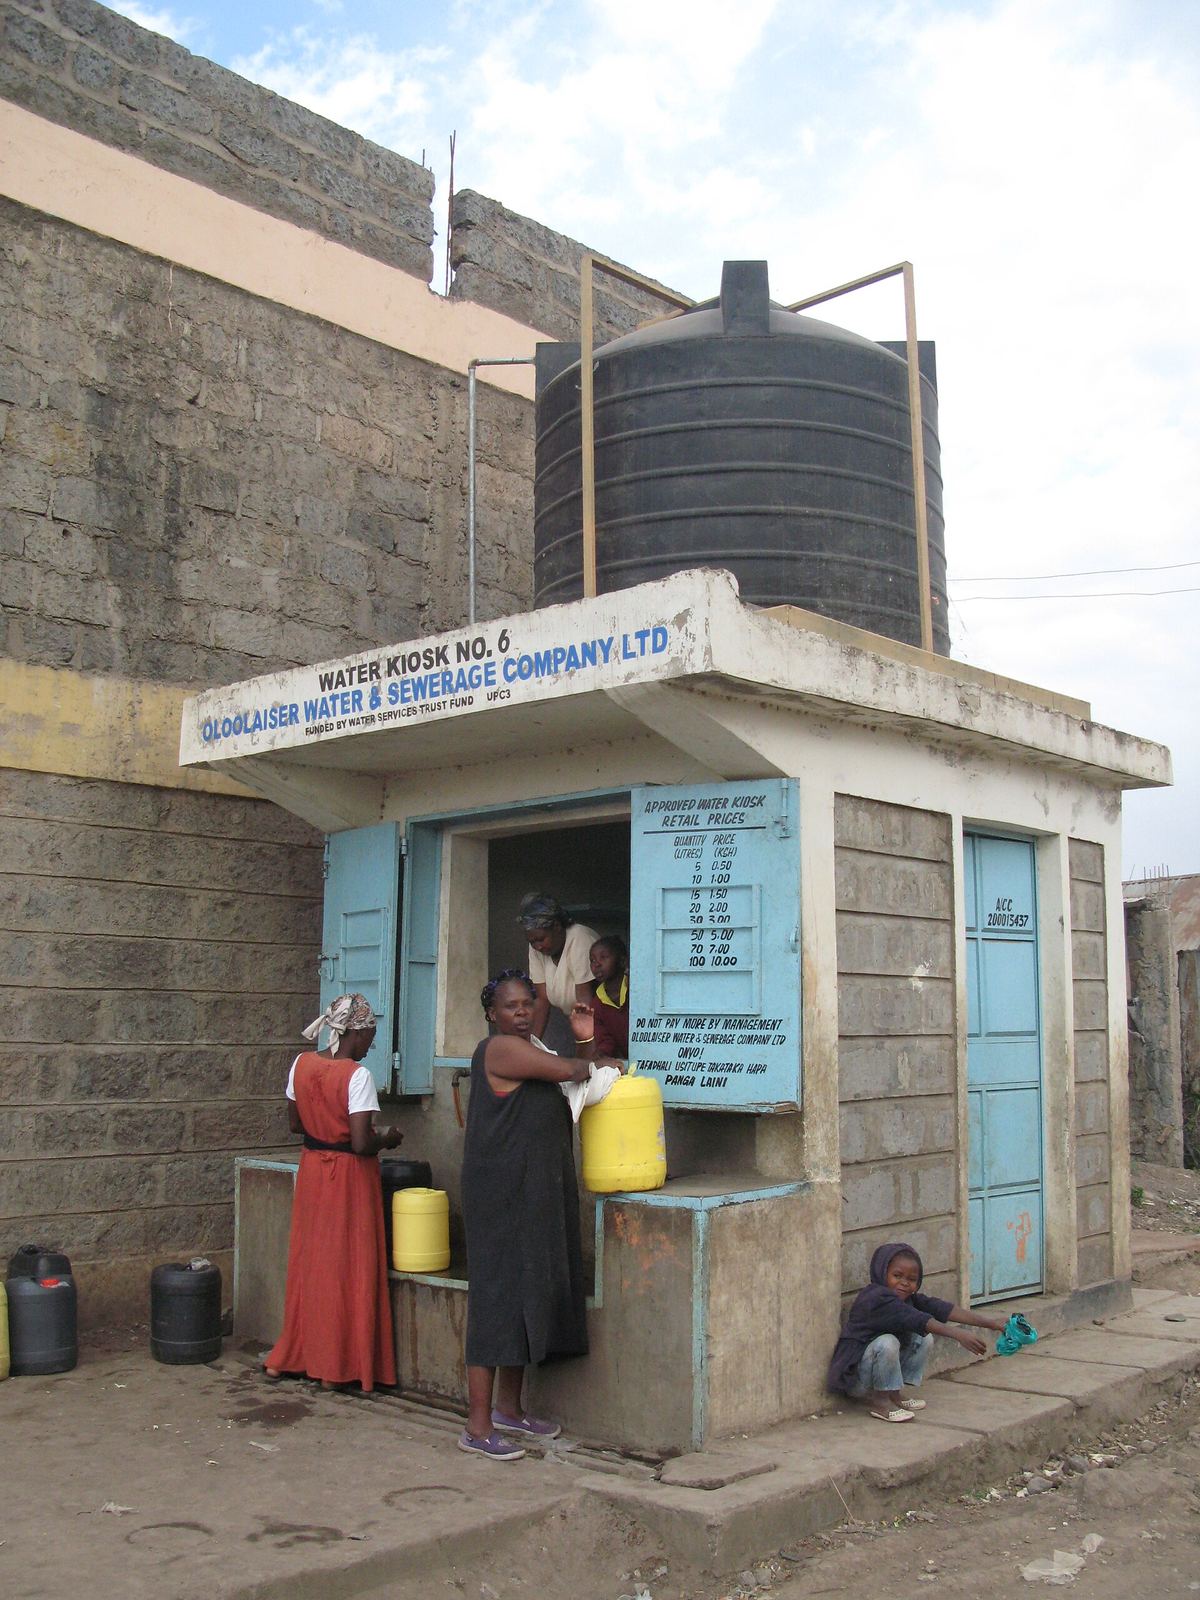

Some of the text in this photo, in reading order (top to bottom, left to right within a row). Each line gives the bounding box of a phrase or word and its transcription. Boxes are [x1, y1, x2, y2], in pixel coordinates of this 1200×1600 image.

[318, 628, 511, 692] WATER KIOSK NO. 6
[202, 626, 668, 742] OLOOLAISER WATER & SEWERAGE COMPANY LTD
[305, 689, 511, 736] FUNDED BY WATER SERVICES TRUST FUND UPC3
[645, 795, 767, 813] APPROVED WATER KIOSK
[662, 812, 746, 827] RETAIL PRICES
[673, 833, 736, 846] QUANTITY PRICE
[674, 846, 738, 859] (LITRES) (KSH)
[695, 860, 732, 871] 5 0.50
[692, 873, 730, 884] 10 1.00
[691, 888, 728, 900] 15 1.50
[689, 902, 728, 913] 20 2.00
[689, 915, 731, 924] 30 300
[690, 929, 734, 941] 50 5.00
[690, 943, 730, 954] 70 7.00
[689, 955, 738, 967] 100 10.00
[636, 1018, 783, 1031] DO NOT PAY MORE BY MANAGEMENT
[672, 1032, 695, 1043] WATER
[695, 1033, 702, 1043] &
[702, 1033, 736, 1045] SEWERAGE
[736, 1034, 772, 1045] COMPANY
[771, 1034, 786, 1045] LTD
[677, 1047, 705, 1060] ONYO!
[636, 1060, 768, 1075] TAFADHALI USITUPE TAKATAKA HAPA
[664, 1074, 728, 1088] PANGA LAINI
